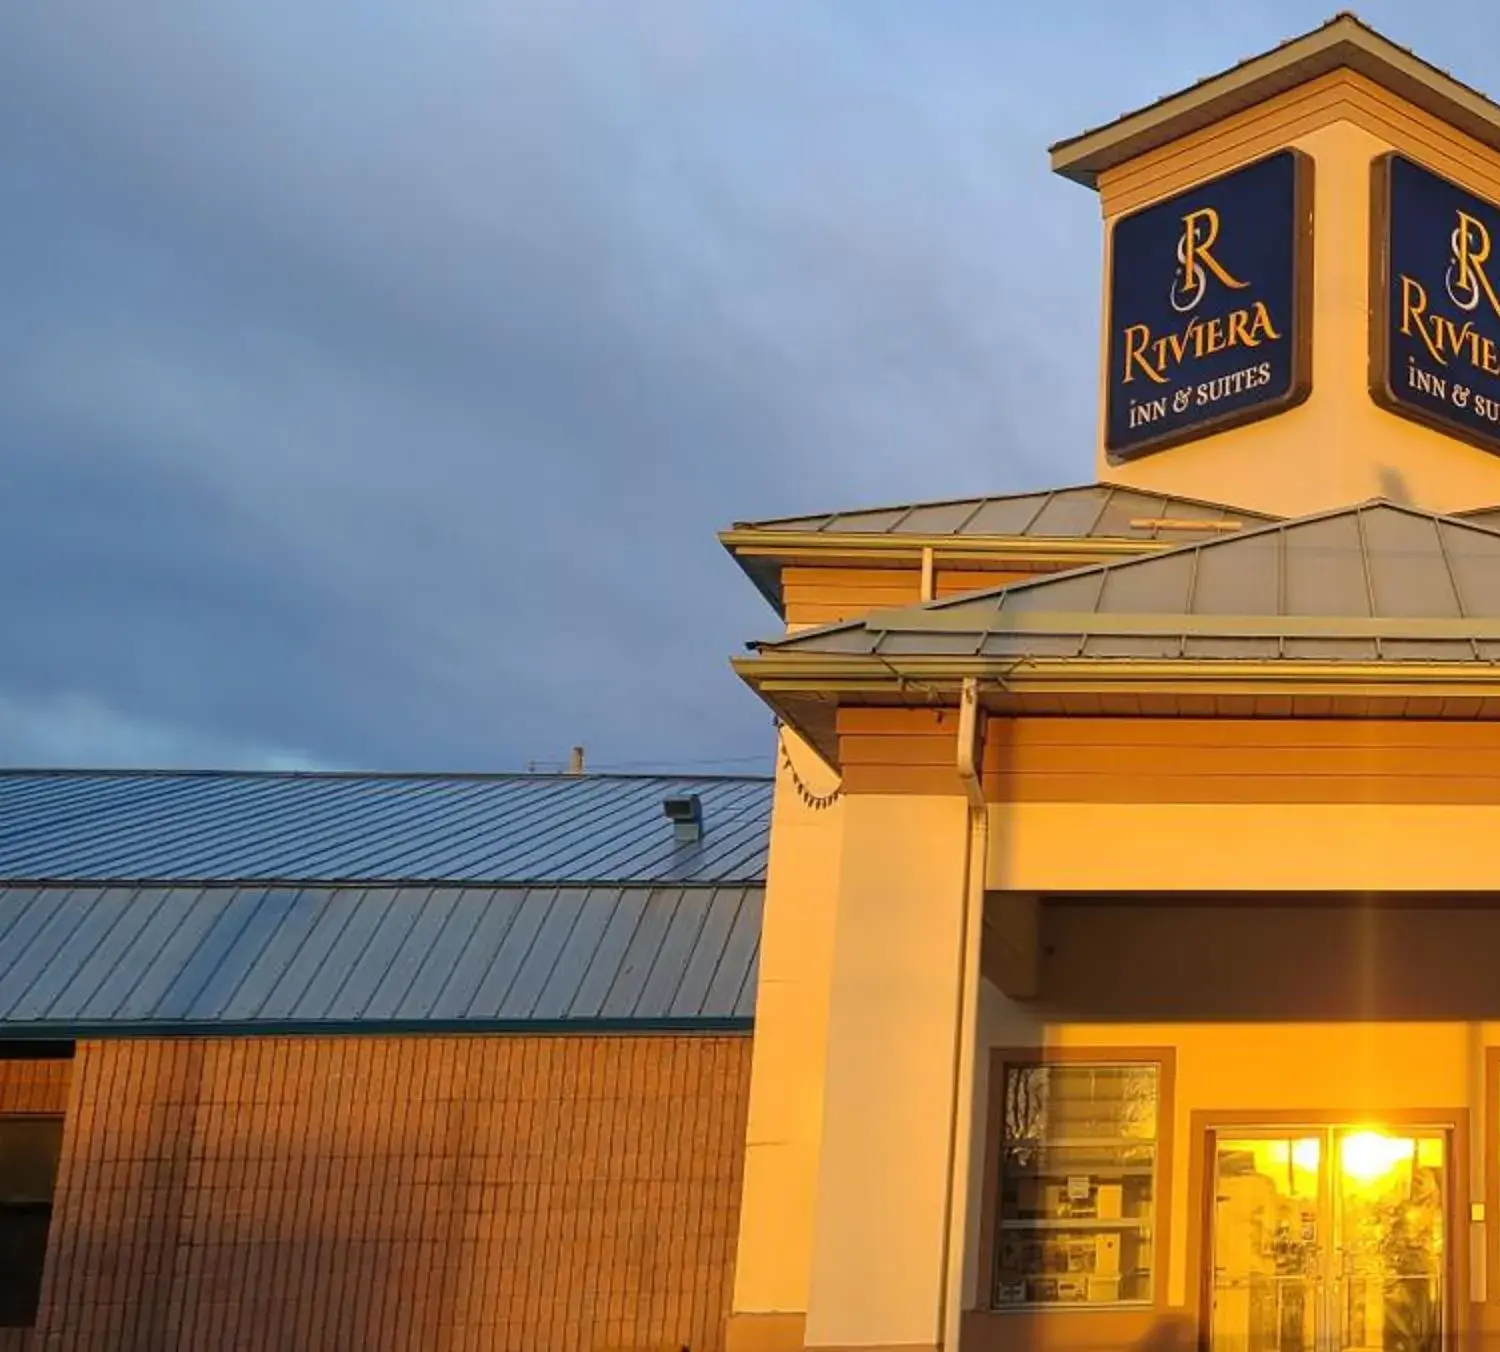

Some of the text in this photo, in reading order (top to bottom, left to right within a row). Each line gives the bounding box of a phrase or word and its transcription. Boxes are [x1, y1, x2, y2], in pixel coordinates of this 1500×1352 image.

[1123, 302, 1281, 383] RIVIERA
[1173, 386, 1193, 412] &
[1197, 363, 1271, 405] SUITES
[1452, 384, 1470, 408] &
